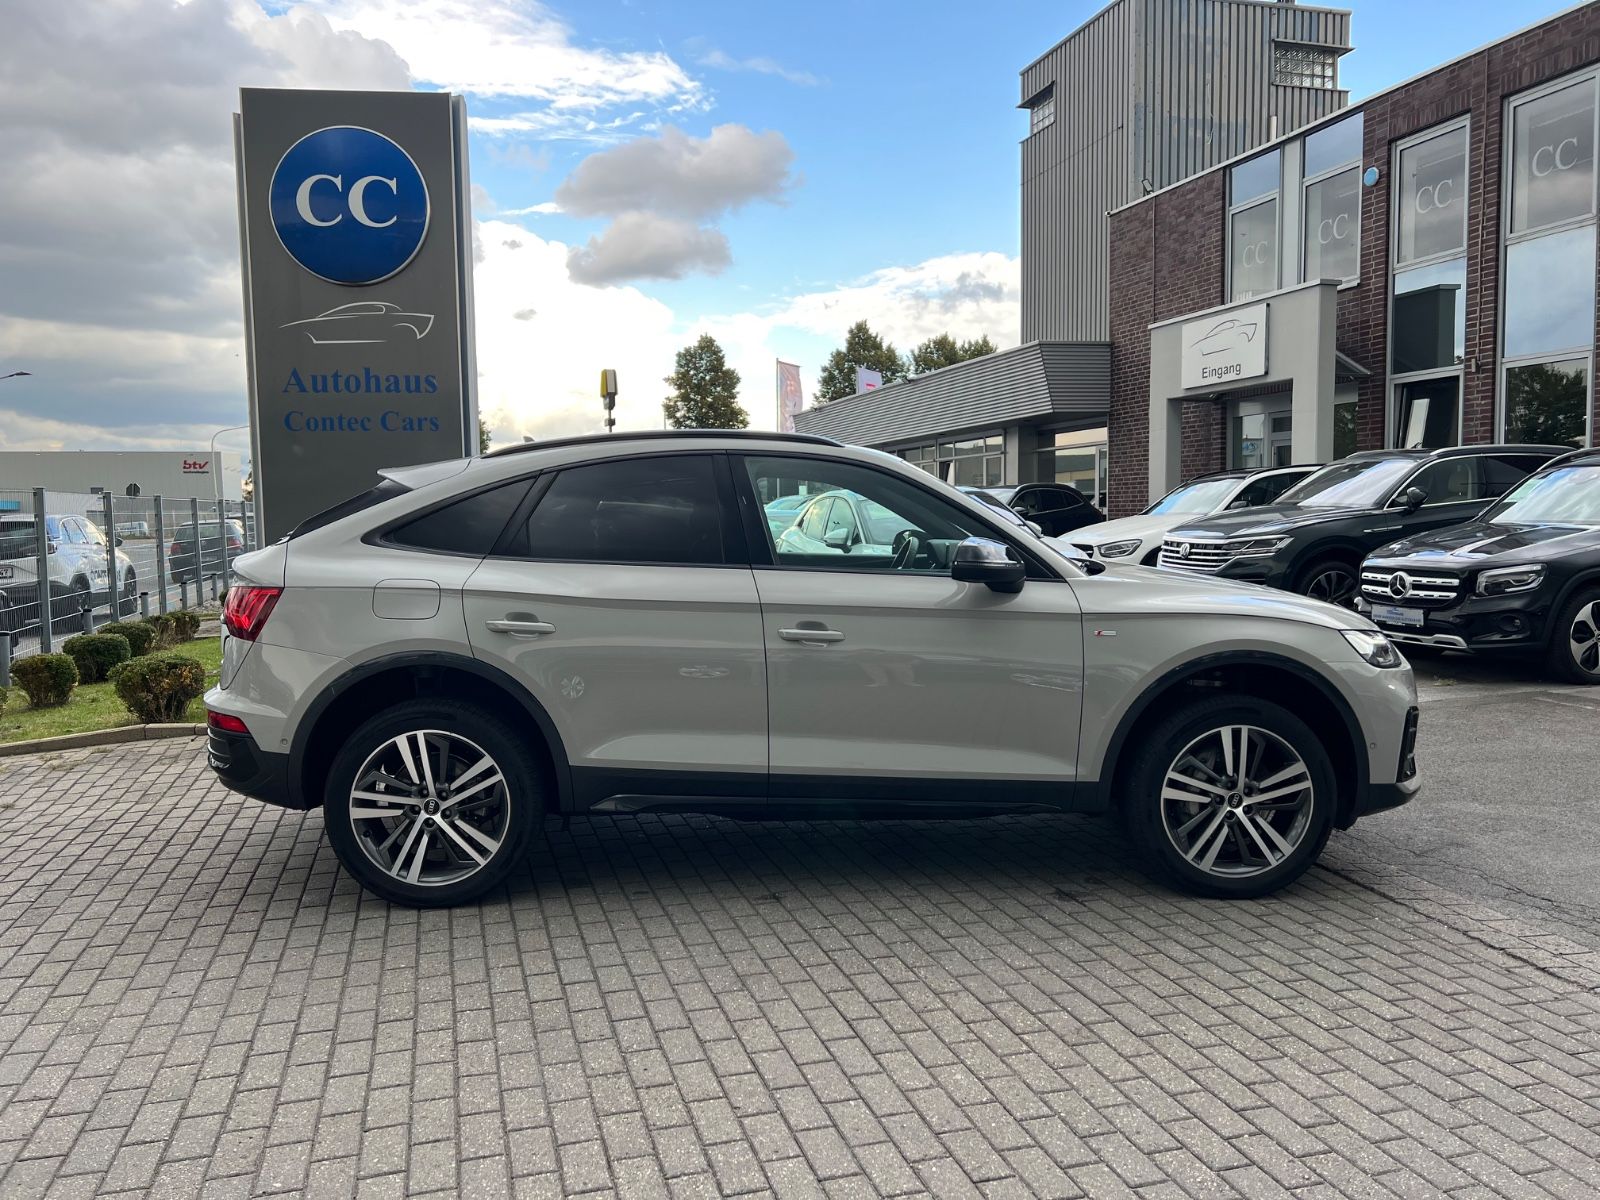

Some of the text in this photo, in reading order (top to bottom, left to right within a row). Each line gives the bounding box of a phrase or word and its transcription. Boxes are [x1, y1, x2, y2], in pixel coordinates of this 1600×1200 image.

[1531, 136, 1578, 178] CC
[295, 173, 398, 228] CC
[1415, 178, 1454, 215] CC
[1317, 213, 1349, 245] CC
[282, 367, 438, 394] Autohaus
[1201, 363, 1242, 379] Eingang
[283, 410, 440, 432] Contec Cars
[182, 459, 209, 470] btv
